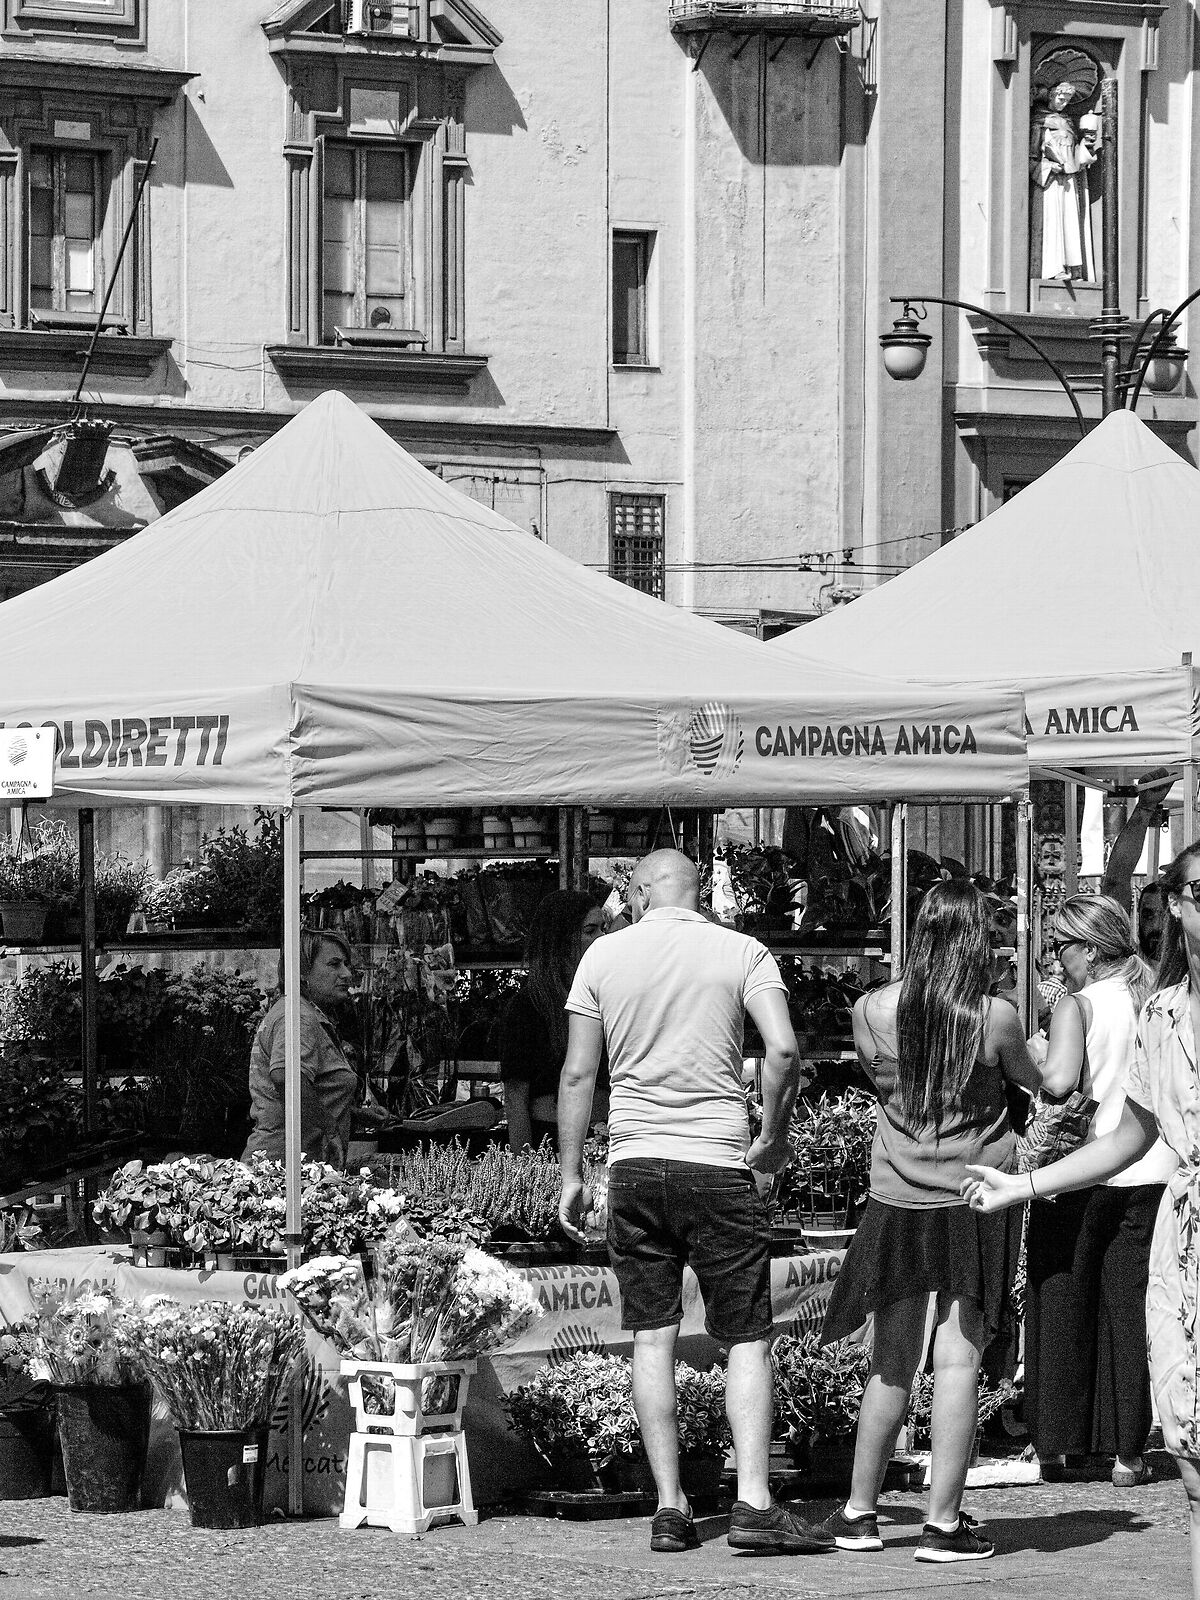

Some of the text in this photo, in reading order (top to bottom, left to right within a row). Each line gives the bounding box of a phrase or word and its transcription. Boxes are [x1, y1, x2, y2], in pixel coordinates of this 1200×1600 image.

[1044, 705, 1140, 735] AMICA
[17, 715, 230, 769] LDIRETTI
[754, 723, 978, 758] CAMPAGNA AMICA
[538, 1279, 614, 1312] AMICA
